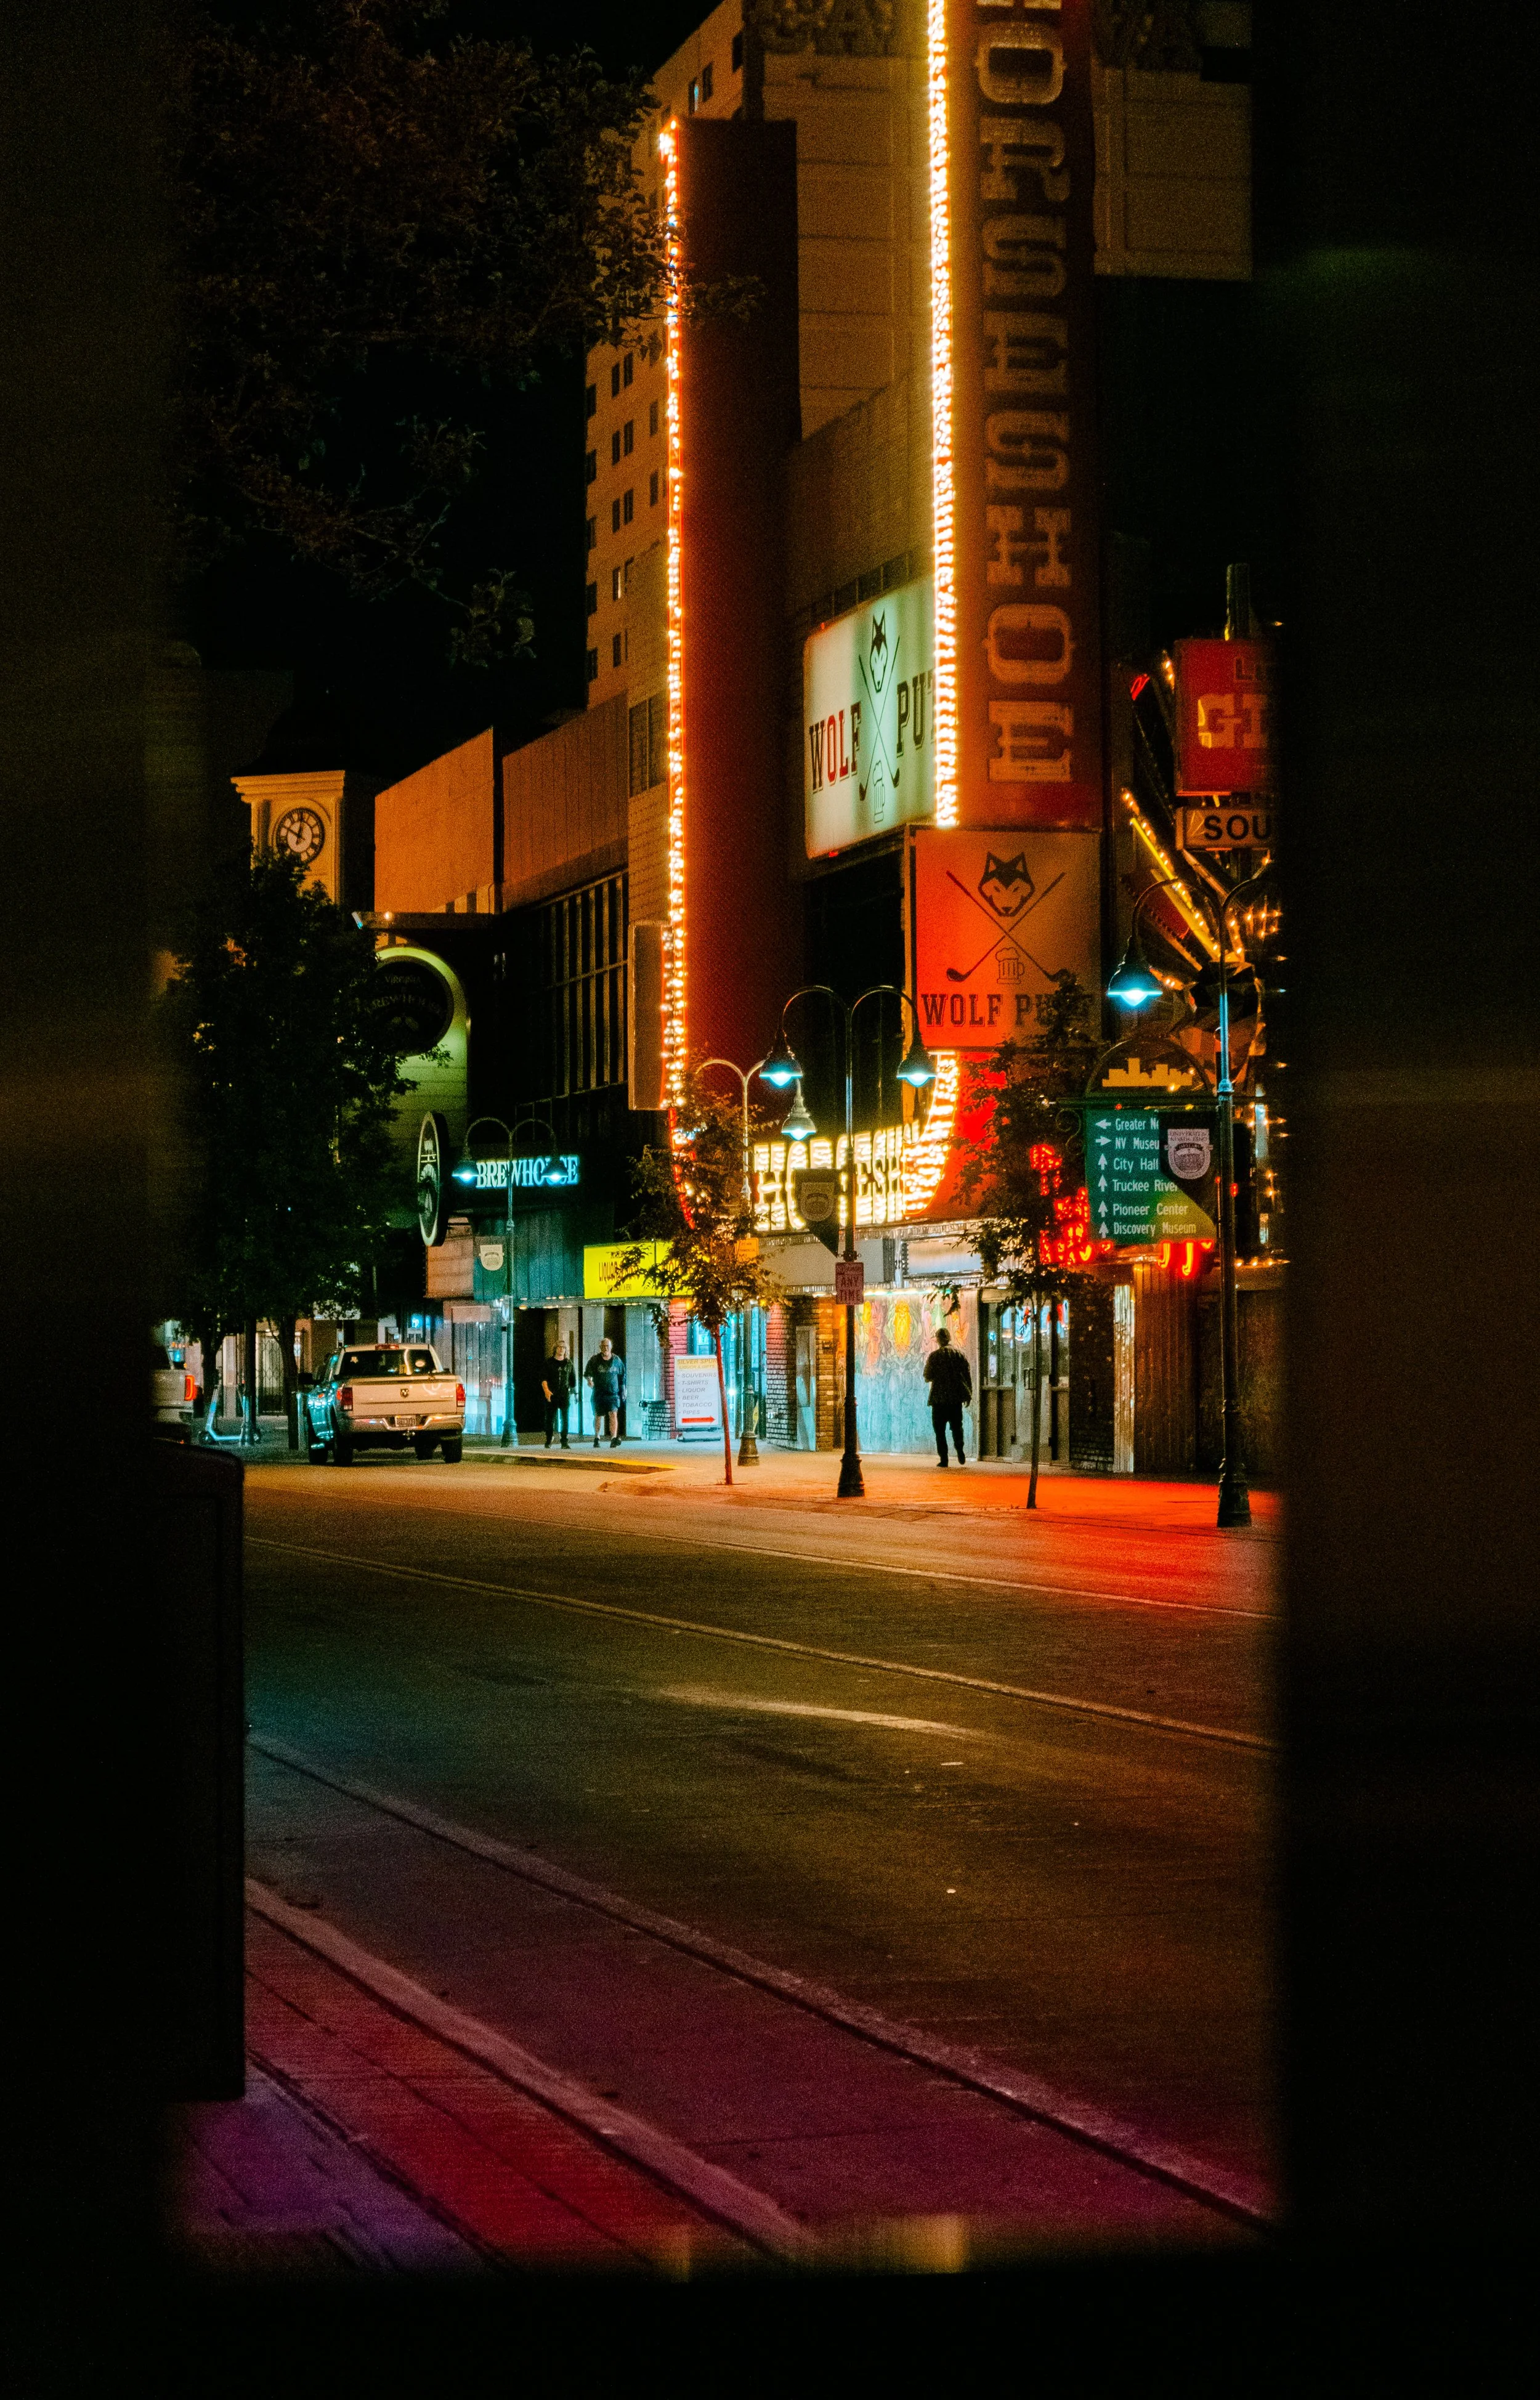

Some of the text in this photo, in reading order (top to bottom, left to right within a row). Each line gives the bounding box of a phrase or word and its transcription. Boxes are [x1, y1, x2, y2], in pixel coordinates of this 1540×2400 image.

[977, 0, 1076, 784] ORSESHOE
[809, 701, 862, 795] WOLF
[1204, 815, 1271, 841] SOU
[921, 994, 1003, 1028] WOLF
[1115, 1118, 1146, 1130] Greater
[1115, 1137, 1159, 1150] NV Museu
[1113, 1157, 1159, 1174] City Hall
[1112, 1179, 1149, 1192] Truckee
[1112, 1202, 1189, 1216] Pioneer Center
[1114, 1222, 1197, 1237] Discovery Museum
